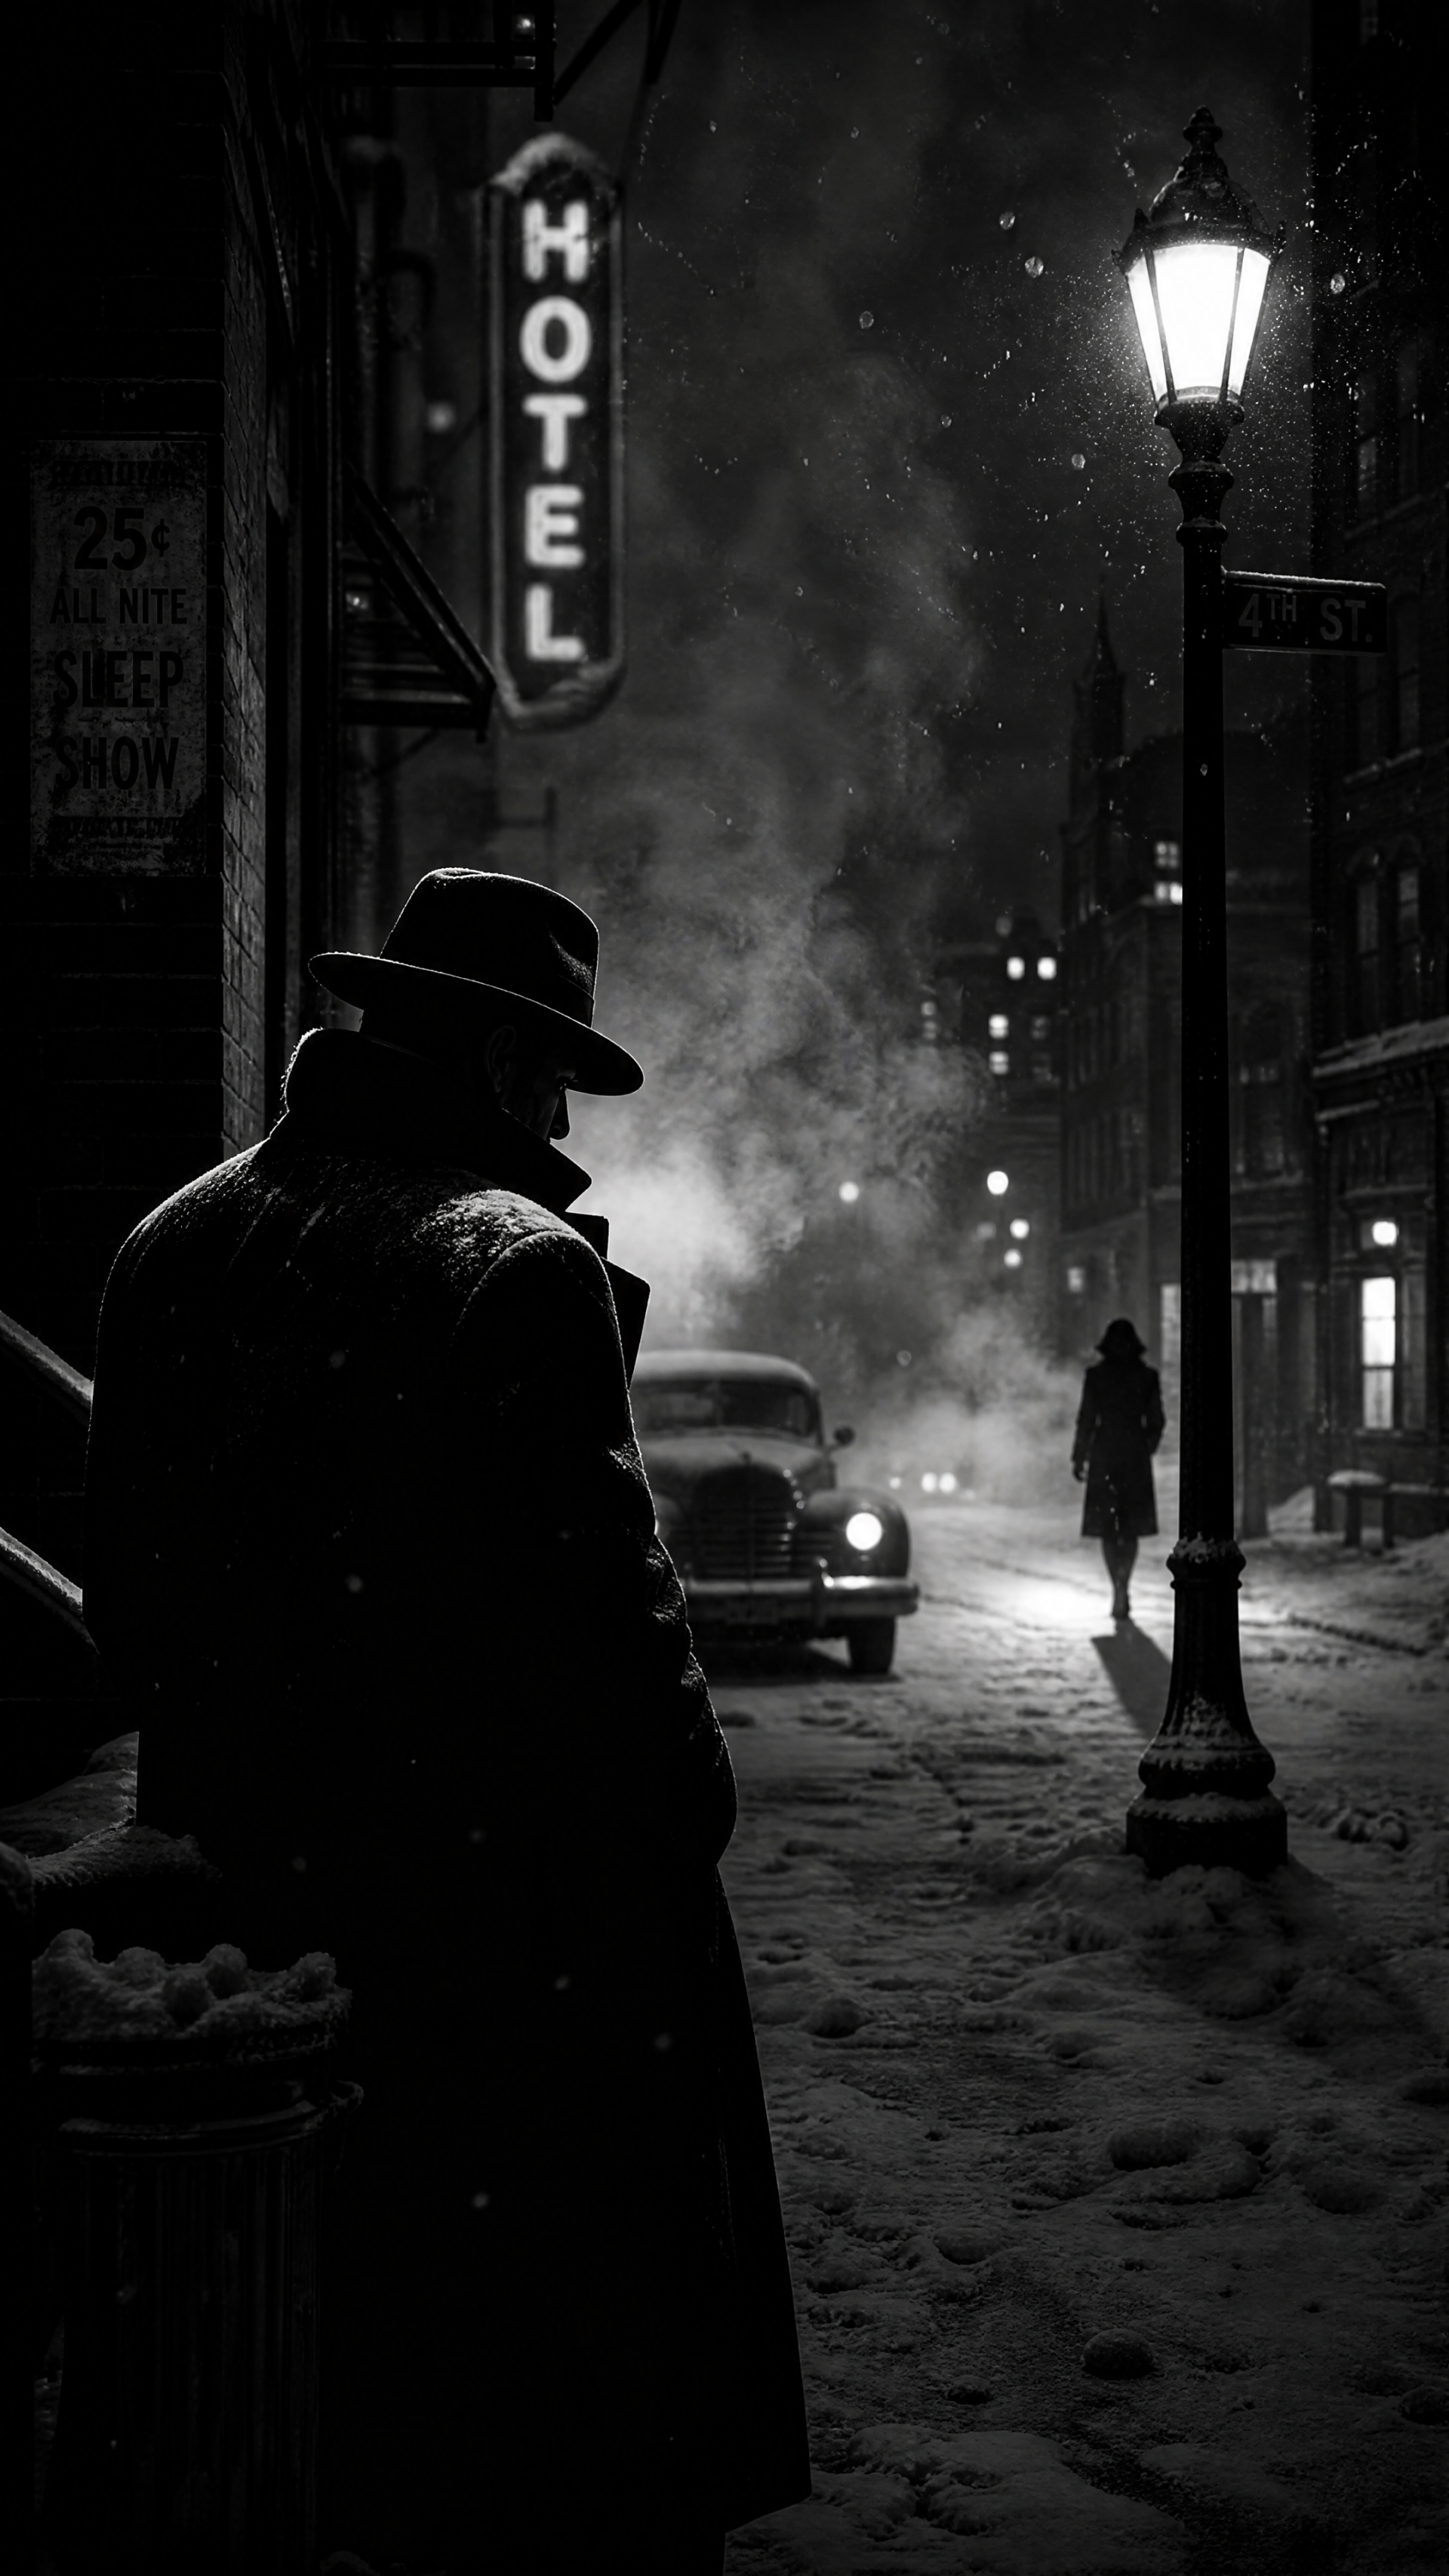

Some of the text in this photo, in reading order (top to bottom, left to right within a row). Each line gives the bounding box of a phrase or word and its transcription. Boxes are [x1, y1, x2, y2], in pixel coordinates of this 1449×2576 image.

[518, 199, 592, 661] HOTEL
[73, 506, 171, 571] 25¢
[50, 587, 188, 625] ALL NITE
[1238, 593, 1373, 643] 4TH ST.
[53, 649, 184, 709] SLEEP
[54, 735, 179, 791] SHOW
